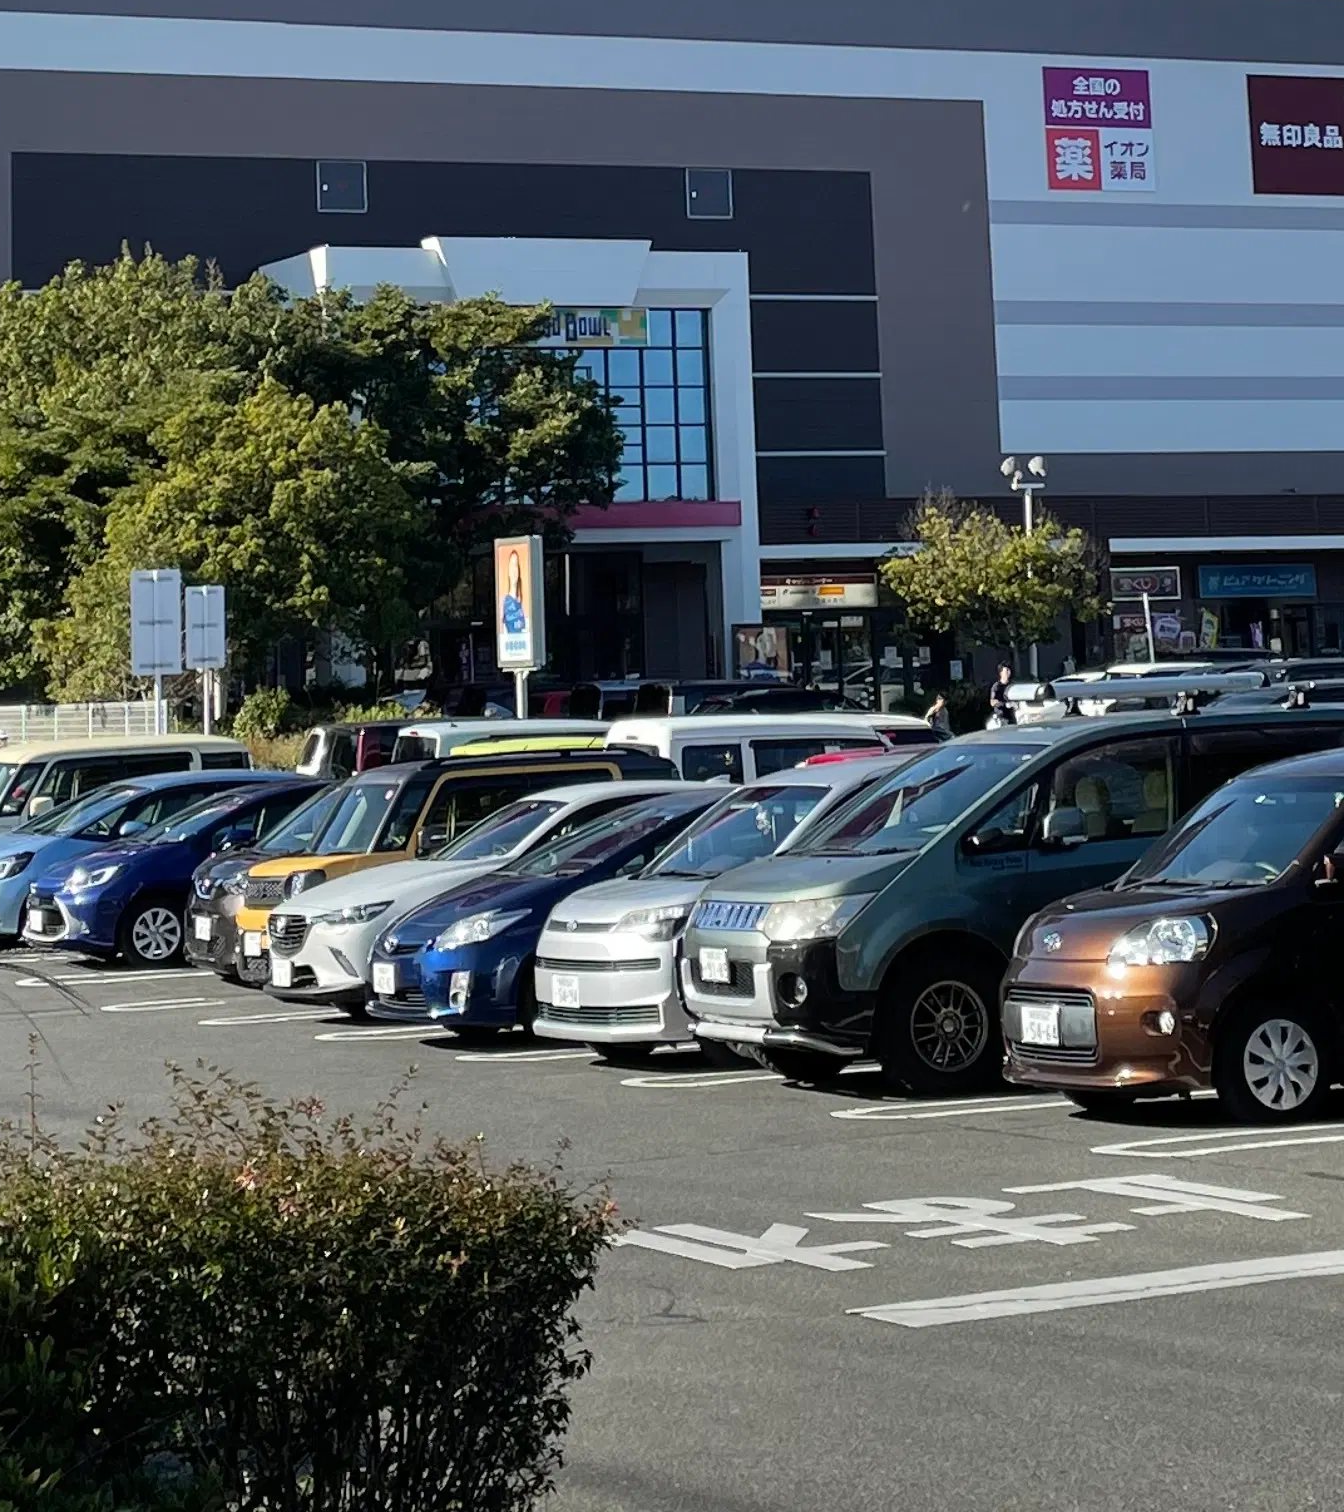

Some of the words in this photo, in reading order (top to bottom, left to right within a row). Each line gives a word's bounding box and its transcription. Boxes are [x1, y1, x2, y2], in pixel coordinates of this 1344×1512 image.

[1072, 76, 1121, 95] 全国の
[1051, 99, 1145, 120] 処方せん受付
[1259, 121, 1344, 148] 無印良品
[1054, 137, 1094, 181] 薬
[1104, 141, 1149, 157] イオン
[1110, 160, 1146, 180] 薬局
